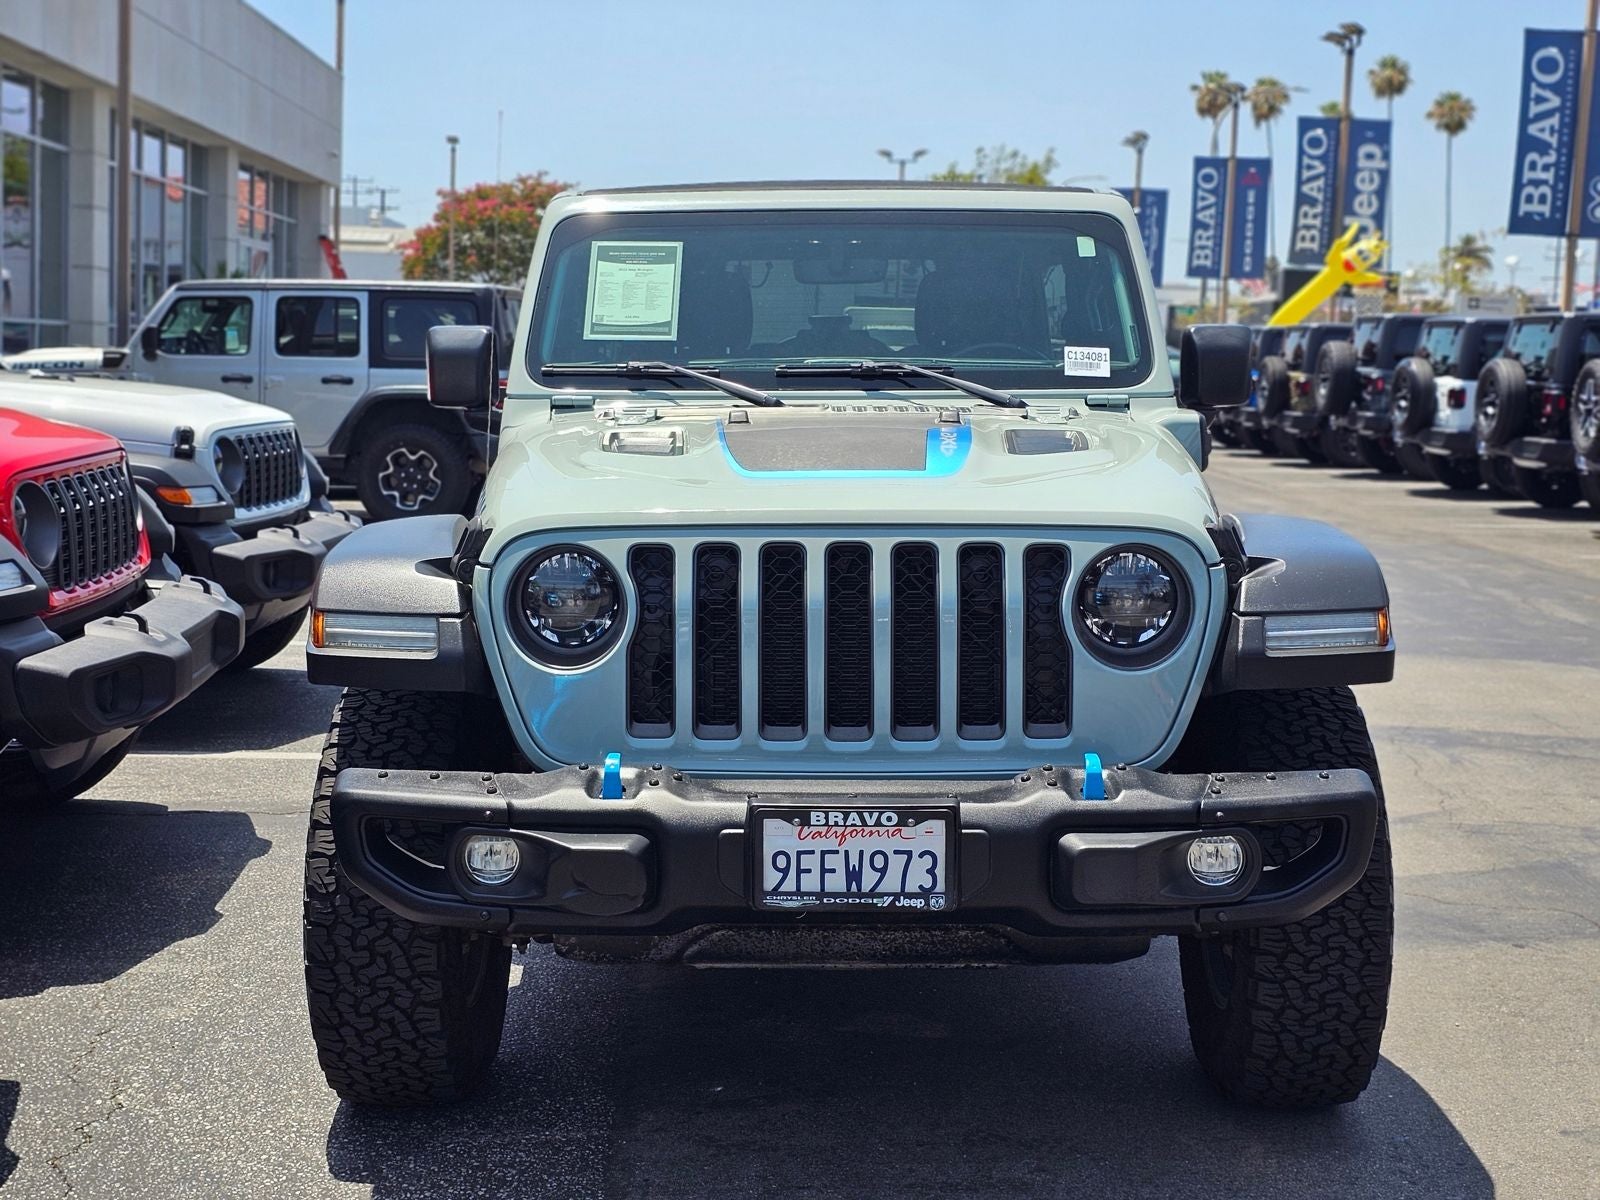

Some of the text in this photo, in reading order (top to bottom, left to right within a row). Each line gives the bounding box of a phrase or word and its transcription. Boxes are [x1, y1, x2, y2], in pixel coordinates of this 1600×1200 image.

[1518, 45, 1565, 218] BRAVO
[1294, 127, 1329, 253] BRAVO
[1343, 142, 1387, 241] Jeep
[1191, 166, 1219, 268] BRAVO
[1067, 350, 1108, 362] C134081
[797, 825, 916, 847] California
[810, 811, 899, 826] BRAVO
[771, 849, 938, 892] 9FFW973
[895, 895, 925, 909] Jeep
